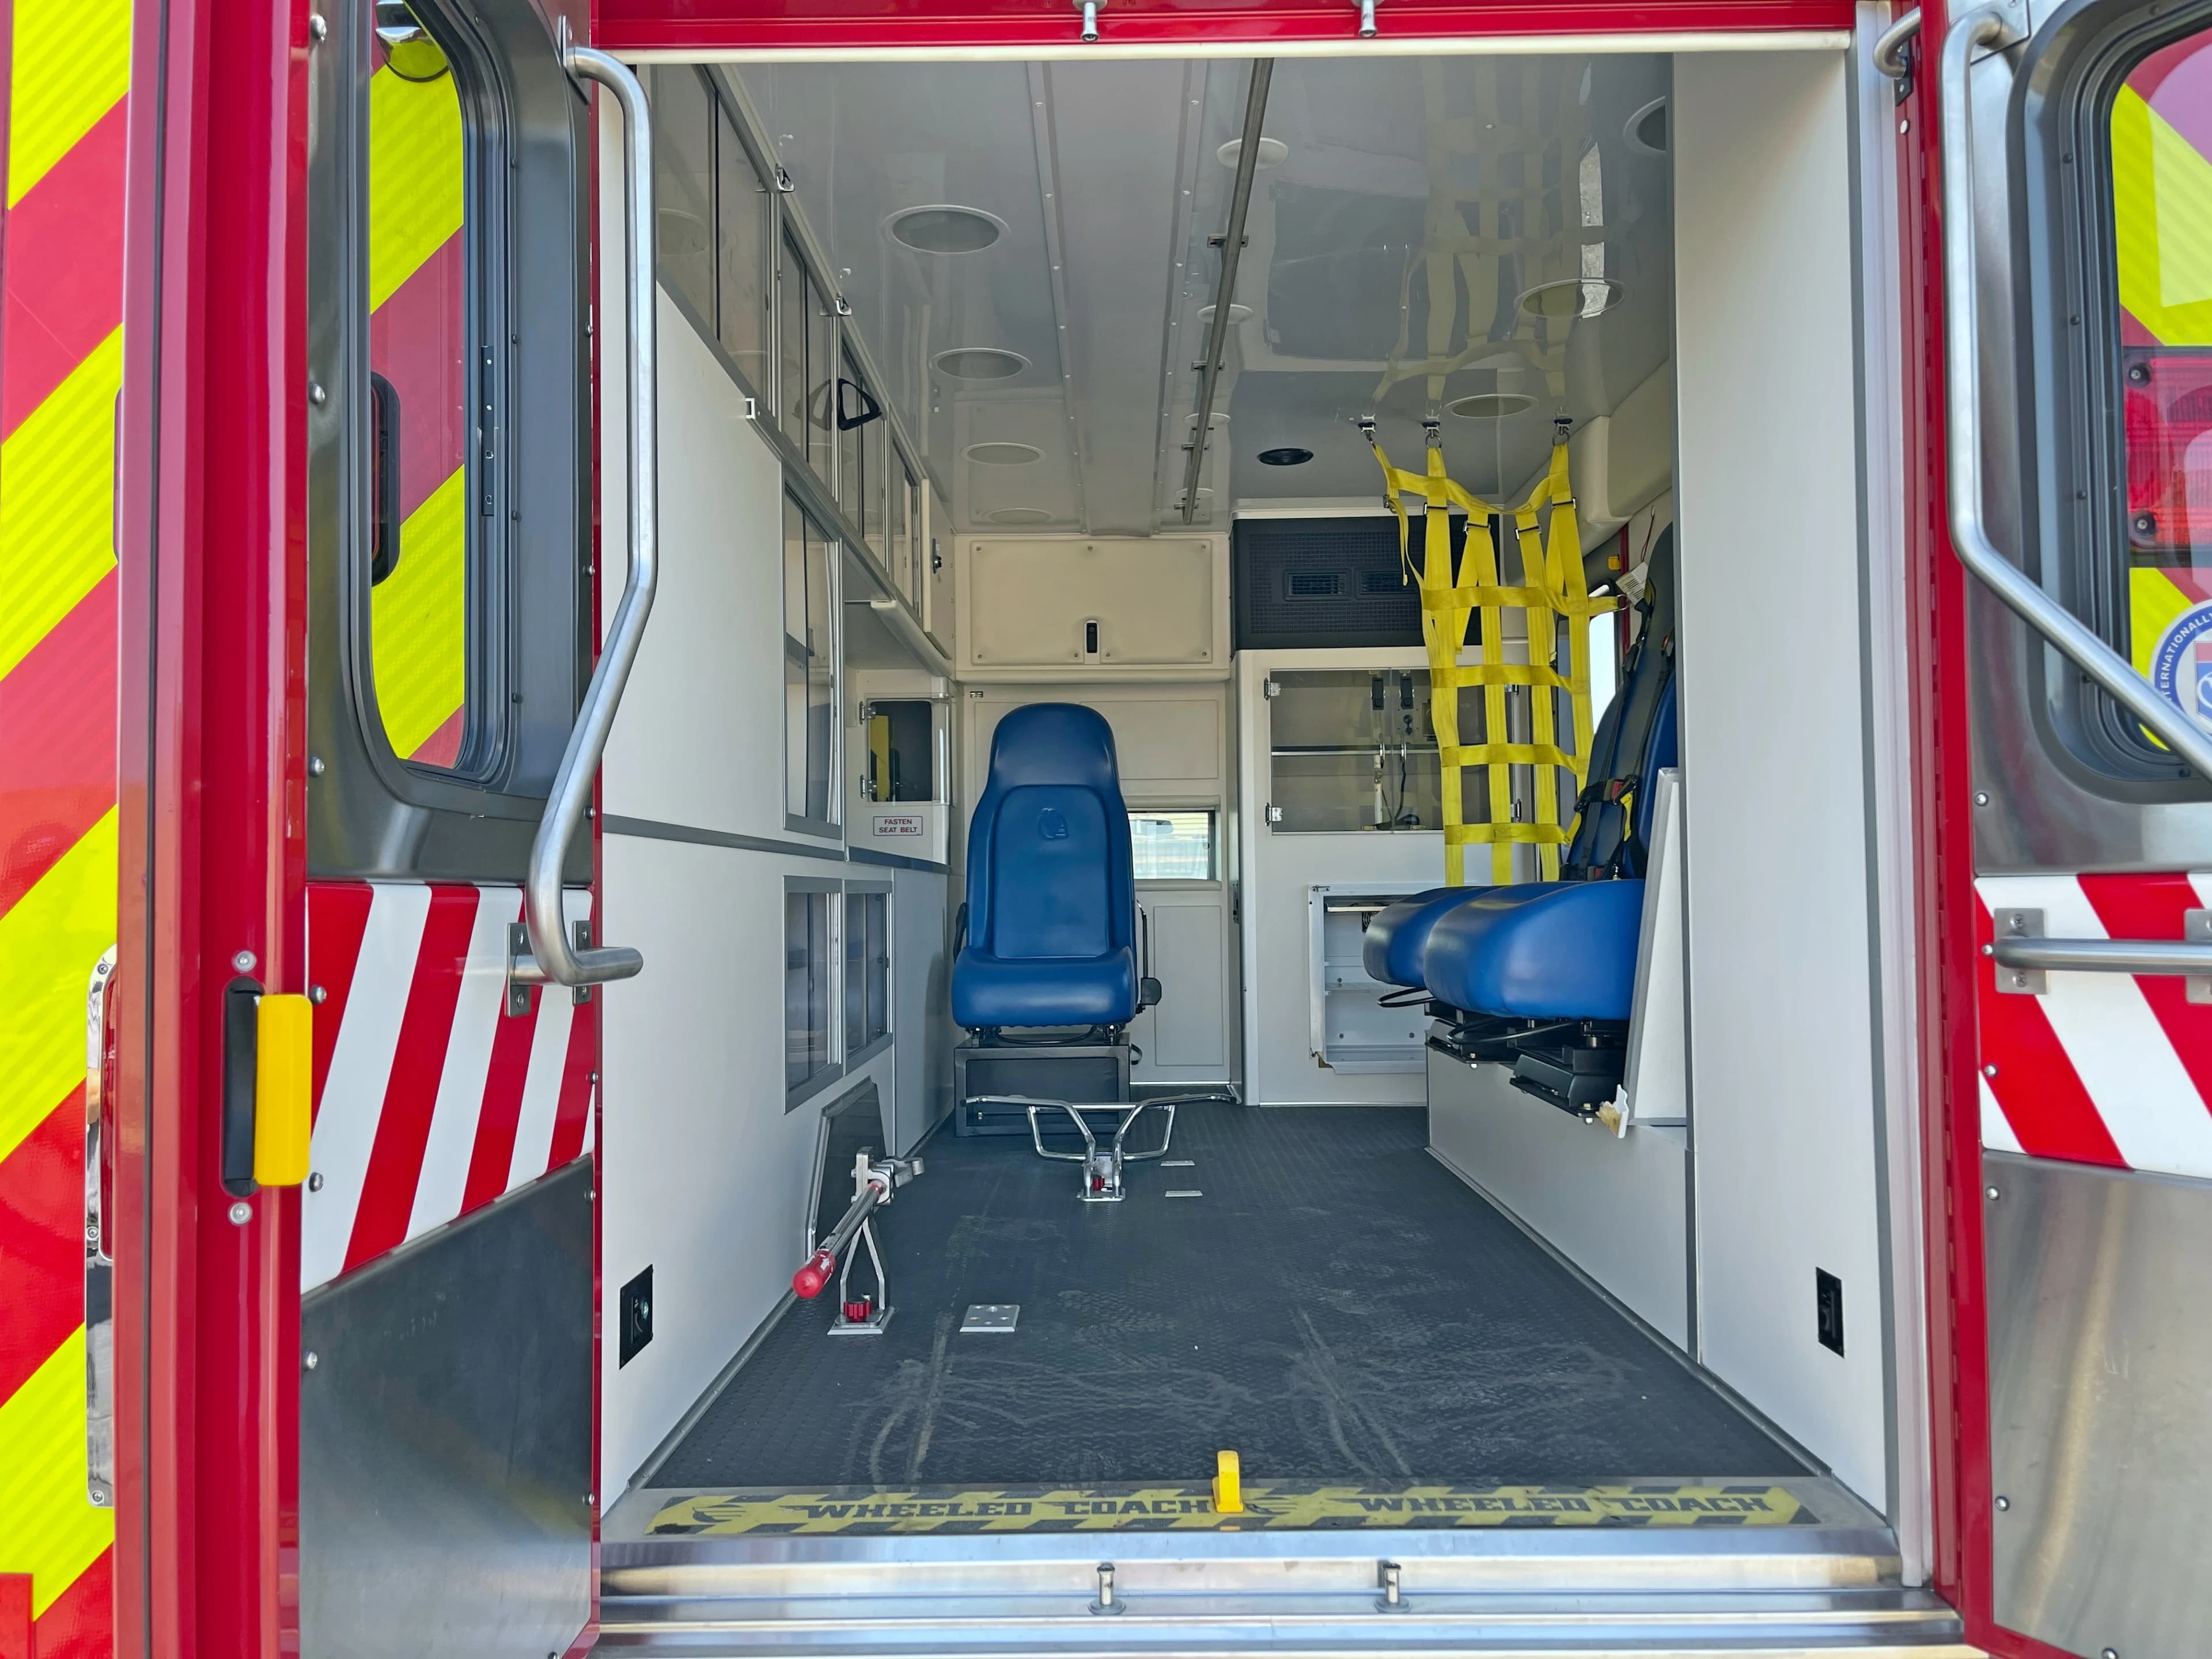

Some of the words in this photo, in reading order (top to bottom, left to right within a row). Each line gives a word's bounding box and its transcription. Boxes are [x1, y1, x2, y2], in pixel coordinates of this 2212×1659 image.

[2160, 613, 2212, 701] TERNATIONALL
[779, 1502, 1032, 1518] WHEELED
[1039, 1499, 1210, 1515] COACH
[1325, 1498, 1592, 1512] WHEELED
[1600, 1497, 1774, 1512] COACH
